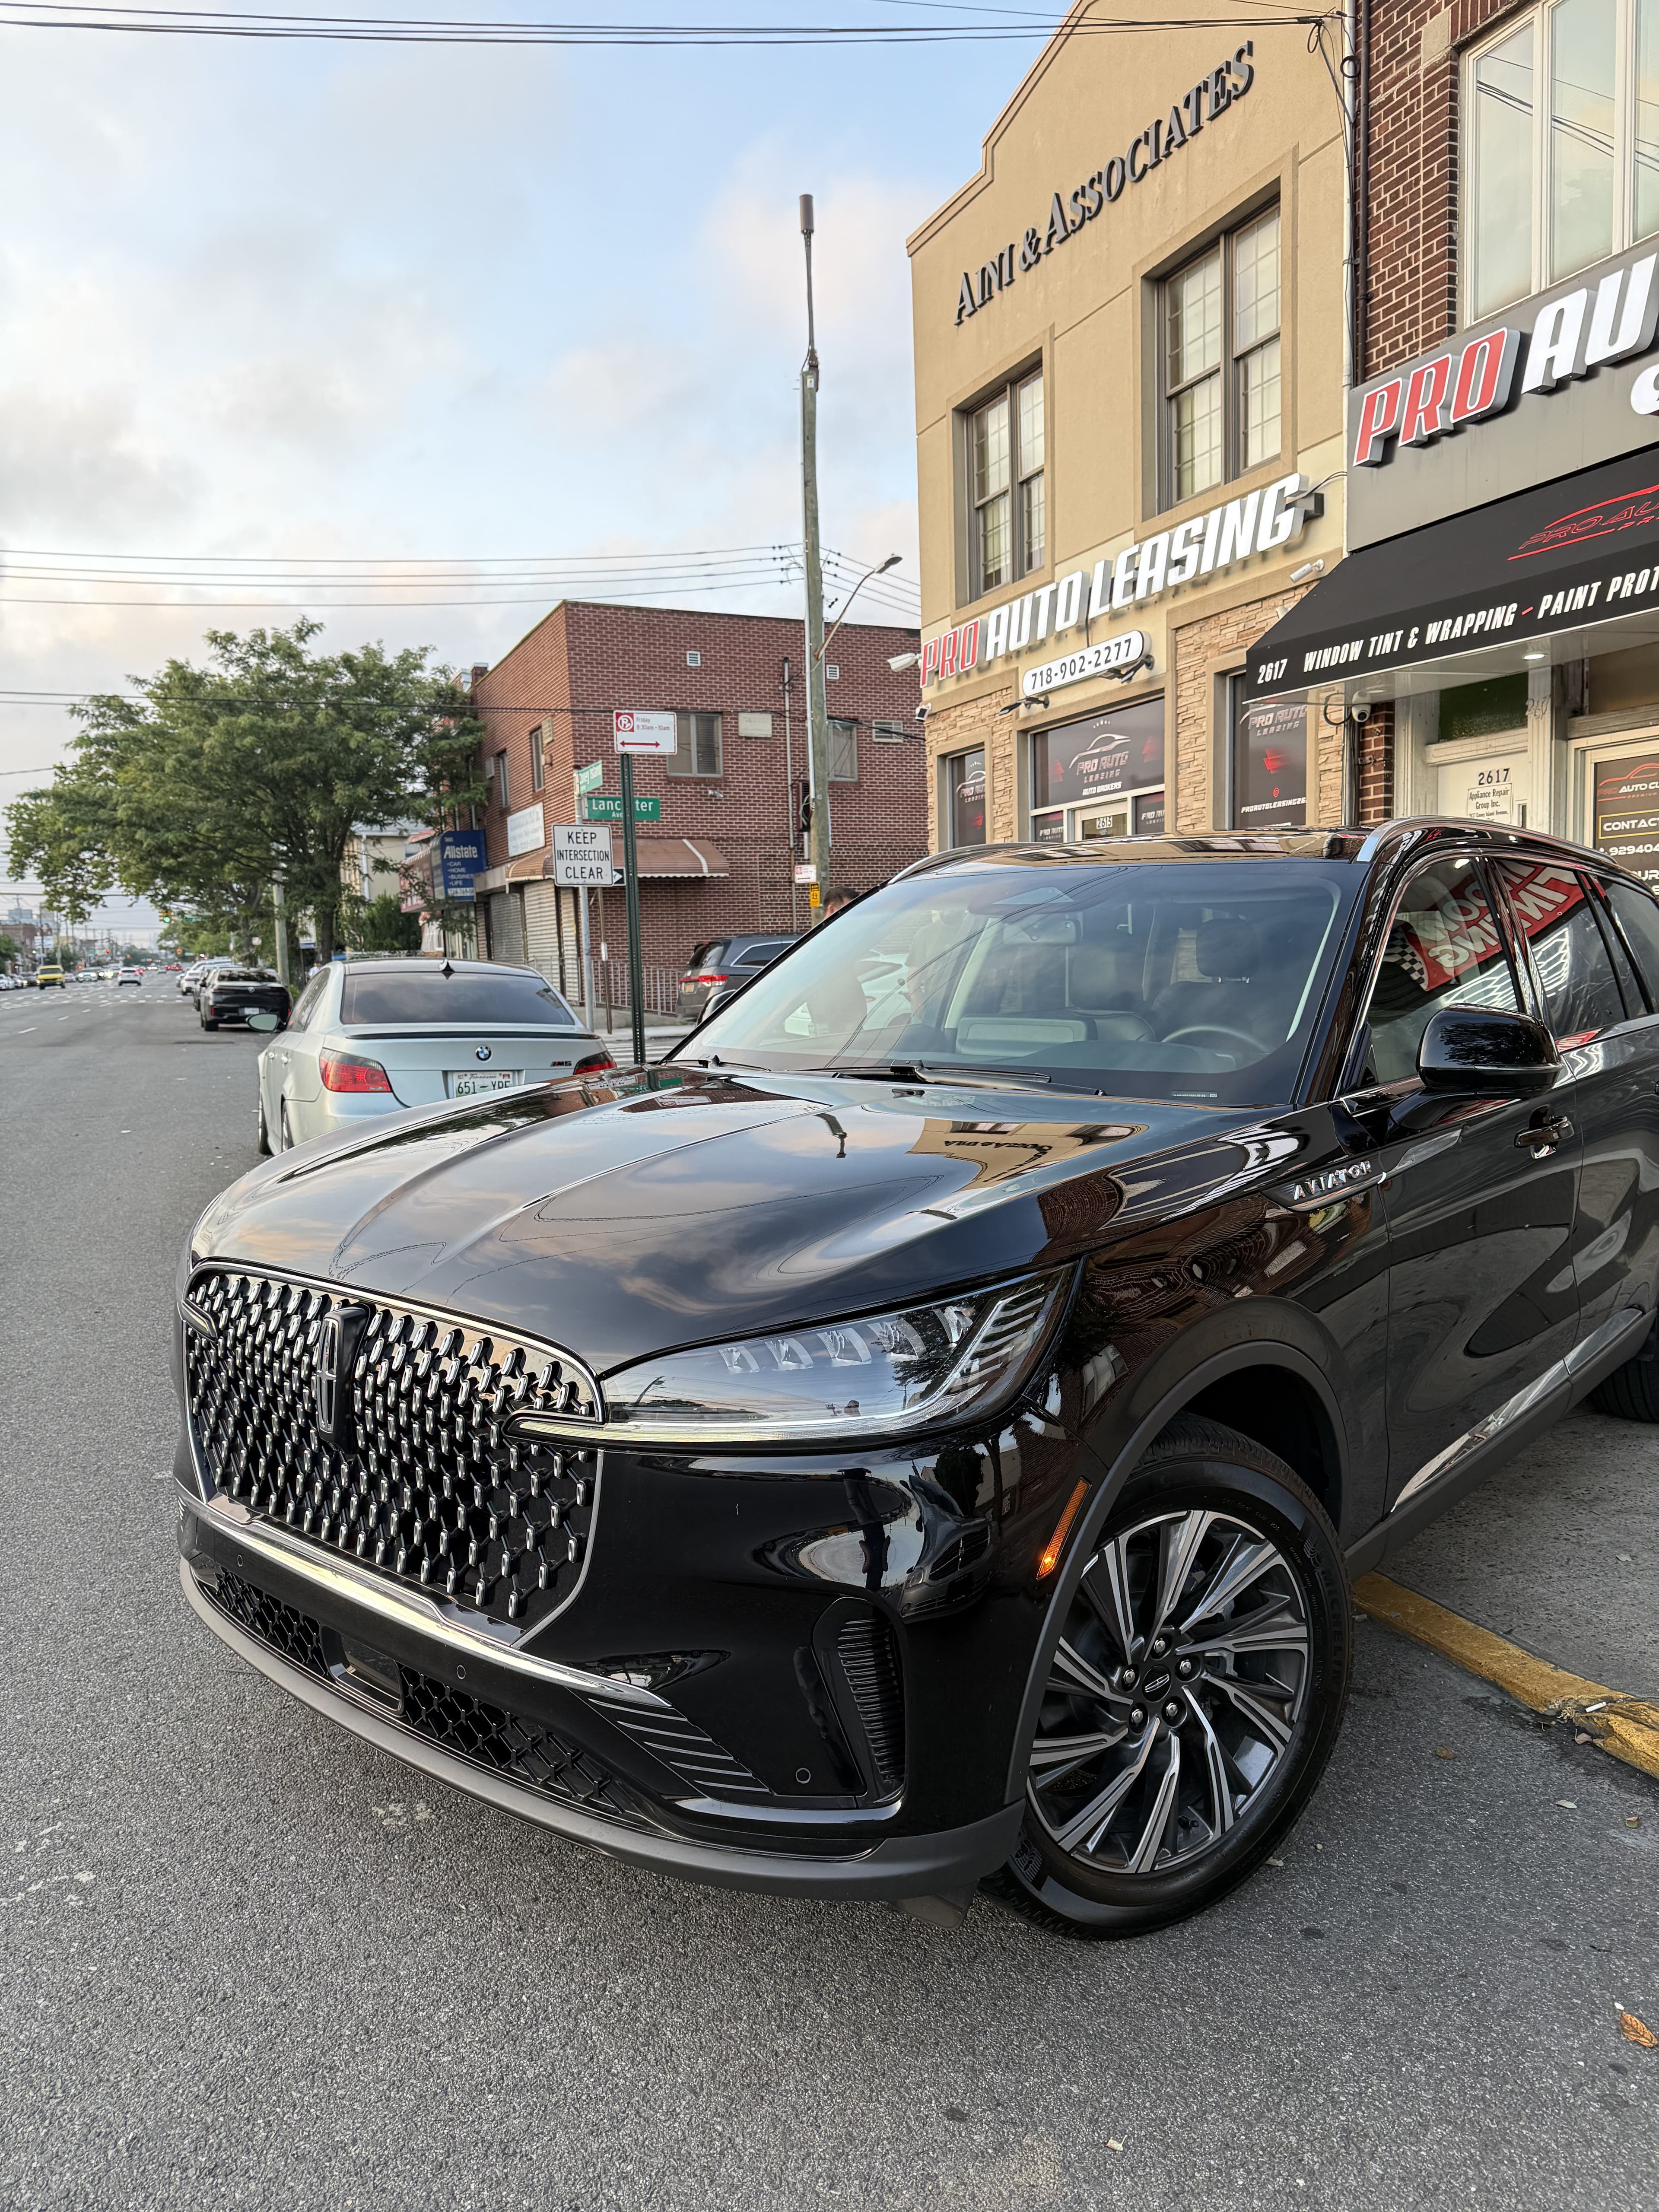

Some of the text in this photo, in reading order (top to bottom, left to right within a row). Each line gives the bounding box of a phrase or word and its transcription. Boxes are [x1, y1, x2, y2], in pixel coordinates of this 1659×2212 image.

[954, 40, 1254, 326] AINI & ASSOCIATES
[1353, 327, 1519, 467] PRO
[1617, 515, 1659, 531] PR
[1519, 515, 1603, 550] PRO
[920, 473, 1308, 688] PRO AUTO LEASING
[1257, 658, 1287, 684] 2617
[1303, 638, 1363, 673] WINDOW
[1369, 630, 1405, 658] TINT
[1407, 626, 1420, 649] &
[1424, 603, 1518, 645] WRAPPING
[1537, 581, 1601, 619] PAINT
[1030, 639, 1133, 690] 718-902-2277
[1248, 704, 1308, 730] PRO AUTO
[1257, 721, 1300, 737] LEASING
[1076, 751, 1129, 775] PRO AUTO
[1084, 769, 1121, 784] LEASING
[1478, 768, 1510, 786] 2617
[1082, 781, 1122, 796] AUTO BROKERS
[1469, 788, 1510, 801] Appliance Repair
[1618, 783, 1648, 794] AUTO
[592, 798, 653, 812] Lancter
[1241, 797, 1306, 813] PROAUTOLEASING26
[1475, 801, 1490, 810] Group
[1098, 816, 1112, 828] 2615
[1141, 811, 1155, 820] PRO
[567, 831, 597, 845] KEEP
[443, 845, 478, 859] Allstate
[556, 849, 610, 861] INTERSECTION
[565, 866, 604, 880] CLEAR
[1294, 1160, 1373, 1201] AVIATOR
